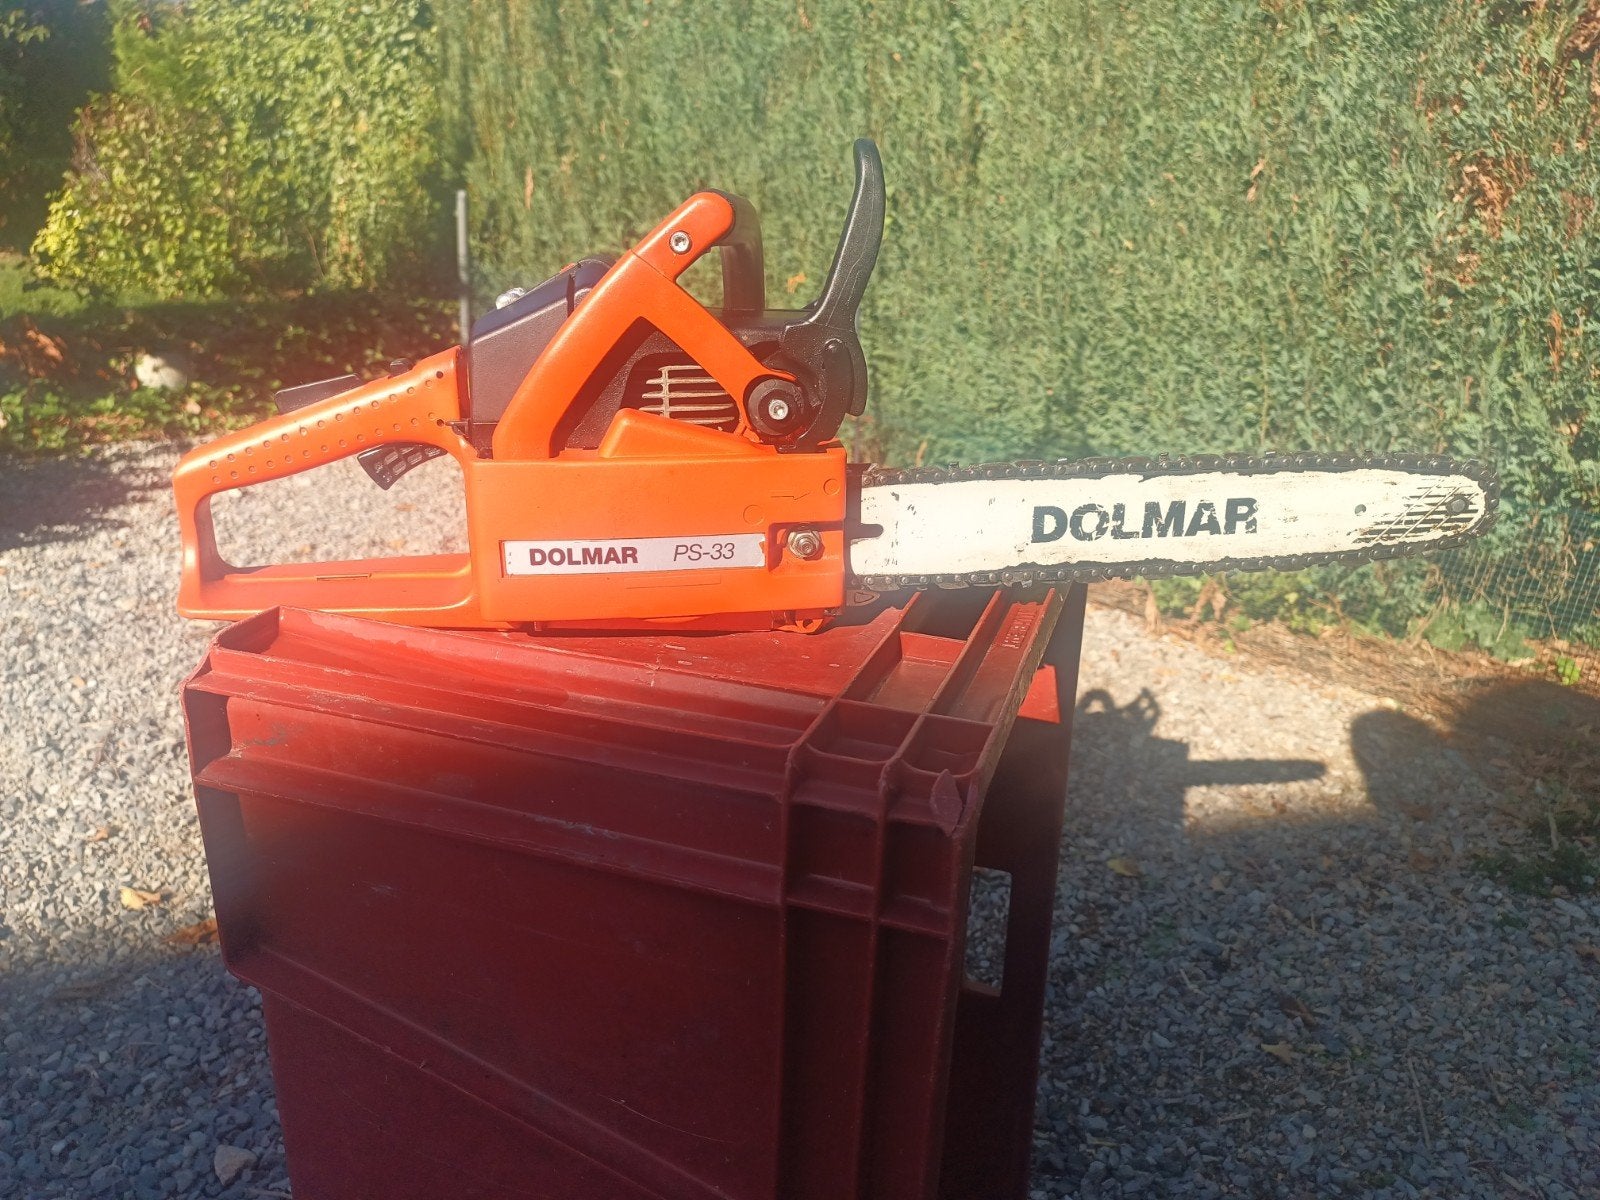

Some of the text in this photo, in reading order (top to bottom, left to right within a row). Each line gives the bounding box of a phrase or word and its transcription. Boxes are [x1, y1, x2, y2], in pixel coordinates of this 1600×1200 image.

[1031, 497, 1258, 543] DOLMAR
[529, 542, 735, 566] DOLMAR PS-33
